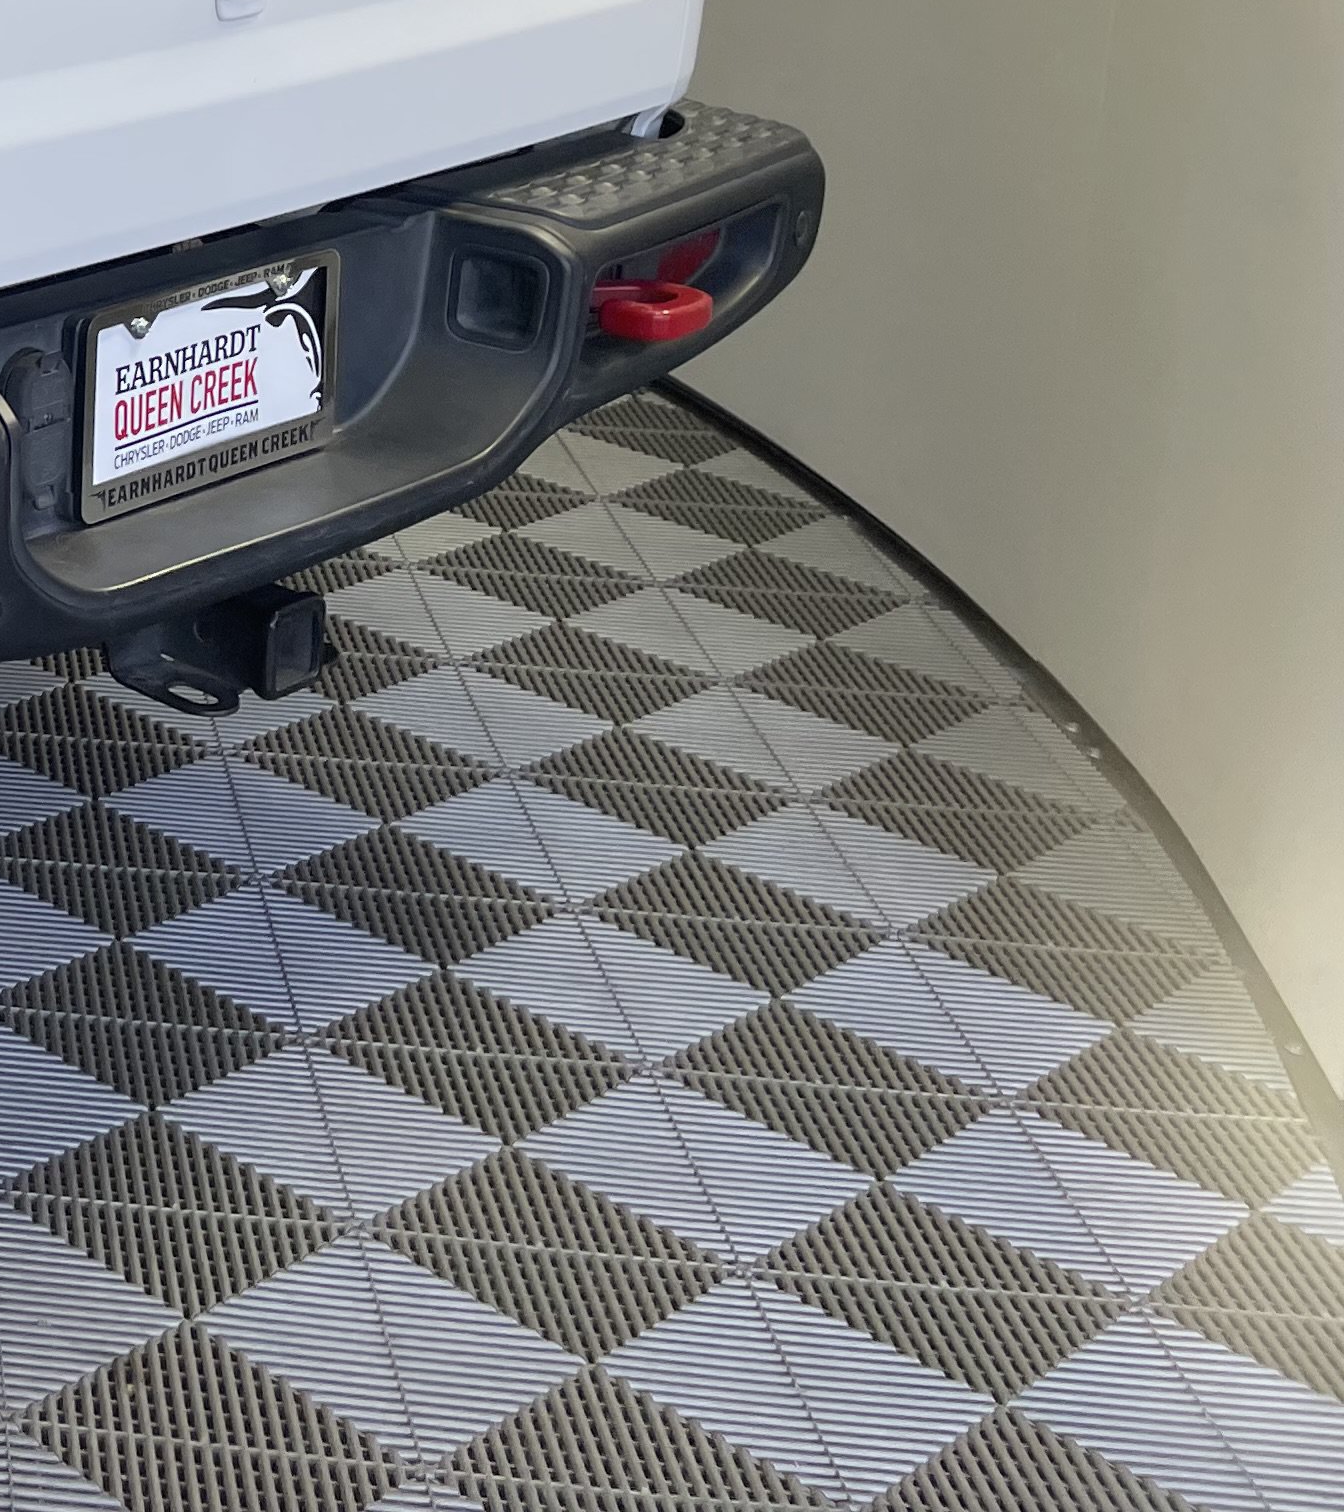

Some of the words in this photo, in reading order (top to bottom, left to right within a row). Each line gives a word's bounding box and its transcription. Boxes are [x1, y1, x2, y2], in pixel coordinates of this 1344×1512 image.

[114, 381, 183, 440] QUEEN
[190, 357, 258, 414] CREEK
[115, 324, 261, 395] EARNHARDT
[108, 459, 206, 508] EARNHARDT
[209, 440, 258, 472] QUEEN
[262, 424, 309, 454] CREEK
